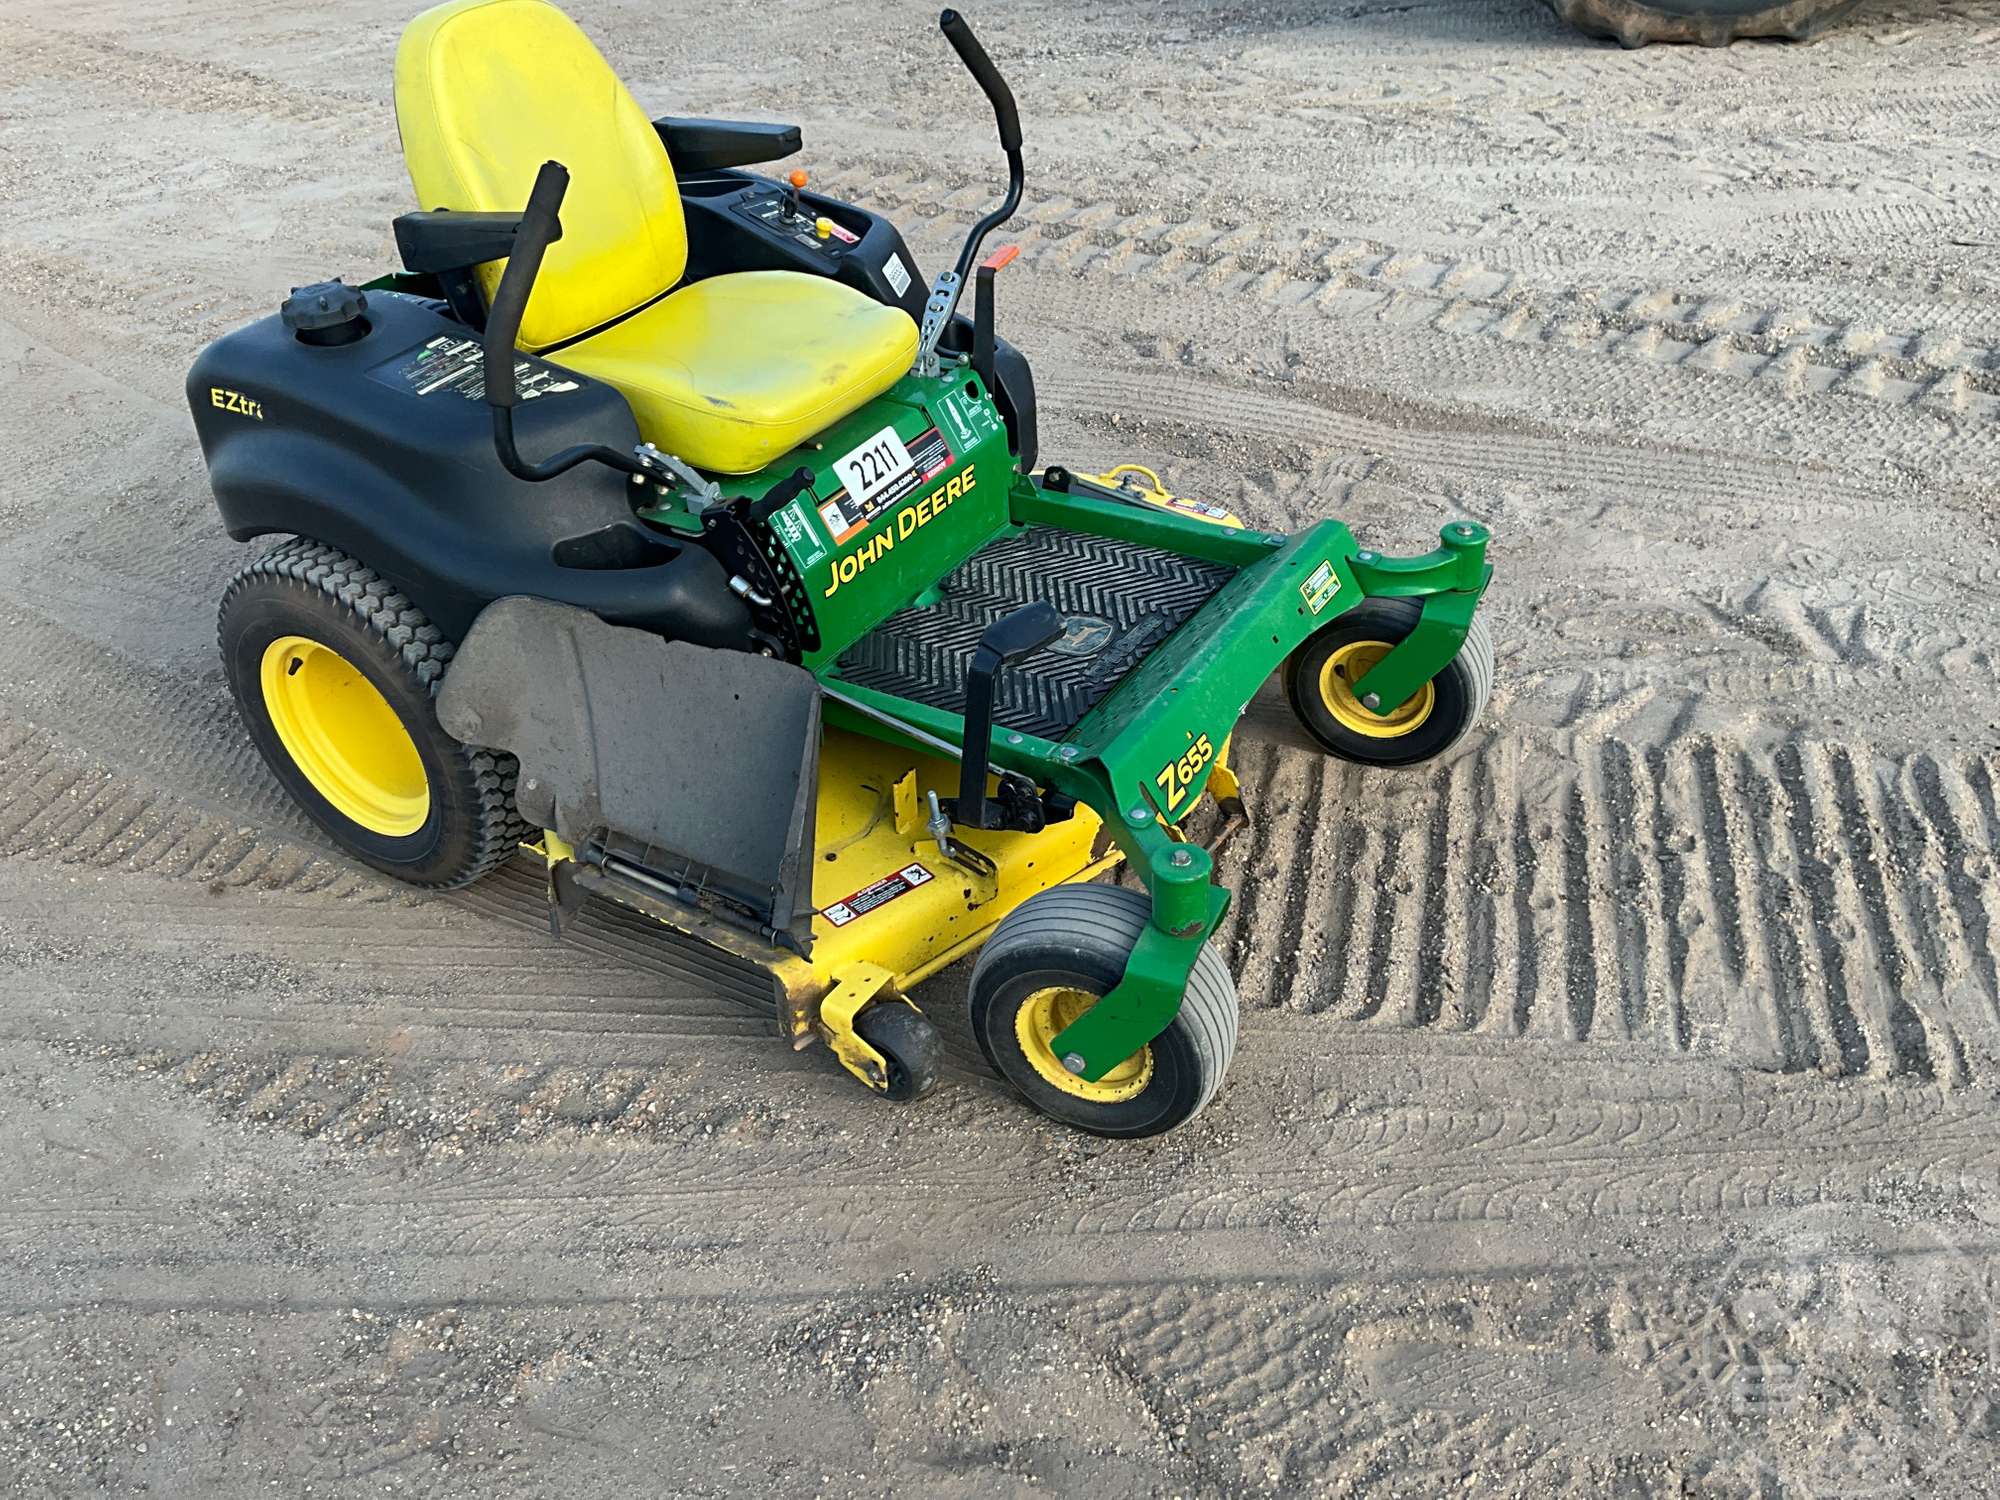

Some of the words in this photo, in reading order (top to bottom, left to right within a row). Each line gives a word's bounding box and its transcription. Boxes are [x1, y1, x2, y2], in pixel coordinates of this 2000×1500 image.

[849, 440, 899, 491] 2211
[824, 525, 895, 598] JOHN
[897, 463, 977, 542] DEERE
[1156, 733, 1213, 812] Z655
